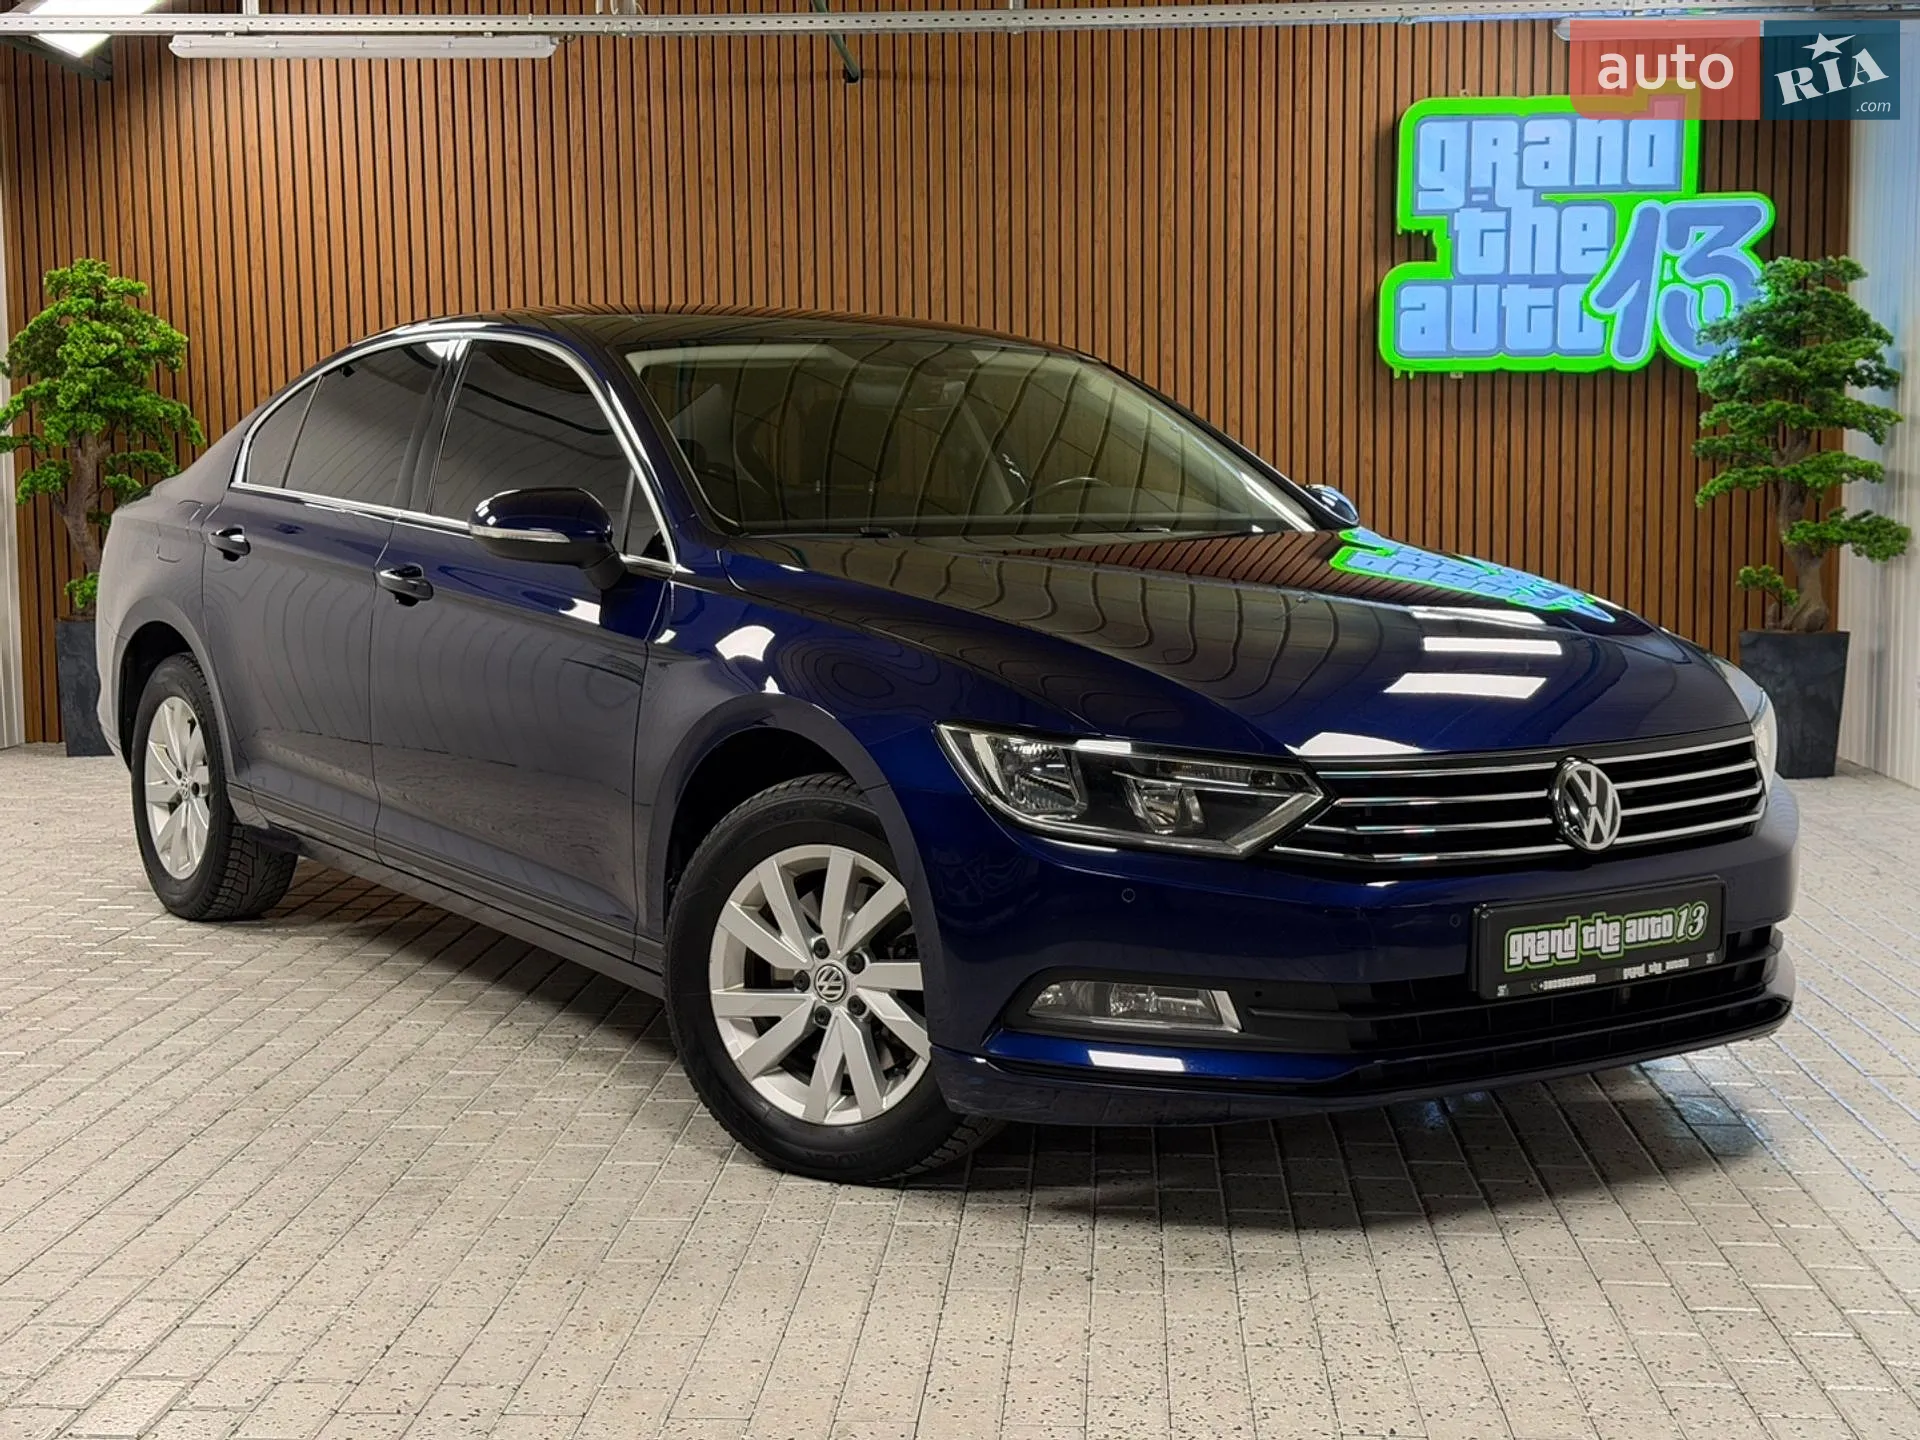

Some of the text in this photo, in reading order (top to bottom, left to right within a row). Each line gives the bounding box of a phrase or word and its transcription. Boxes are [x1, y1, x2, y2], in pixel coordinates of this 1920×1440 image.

[1454, 189, 1609, 275] the
[1582, 918, 1620, 953] the
[1625, 913, 1674, 944] auto
[1676, 905, 1706, 938] 13
